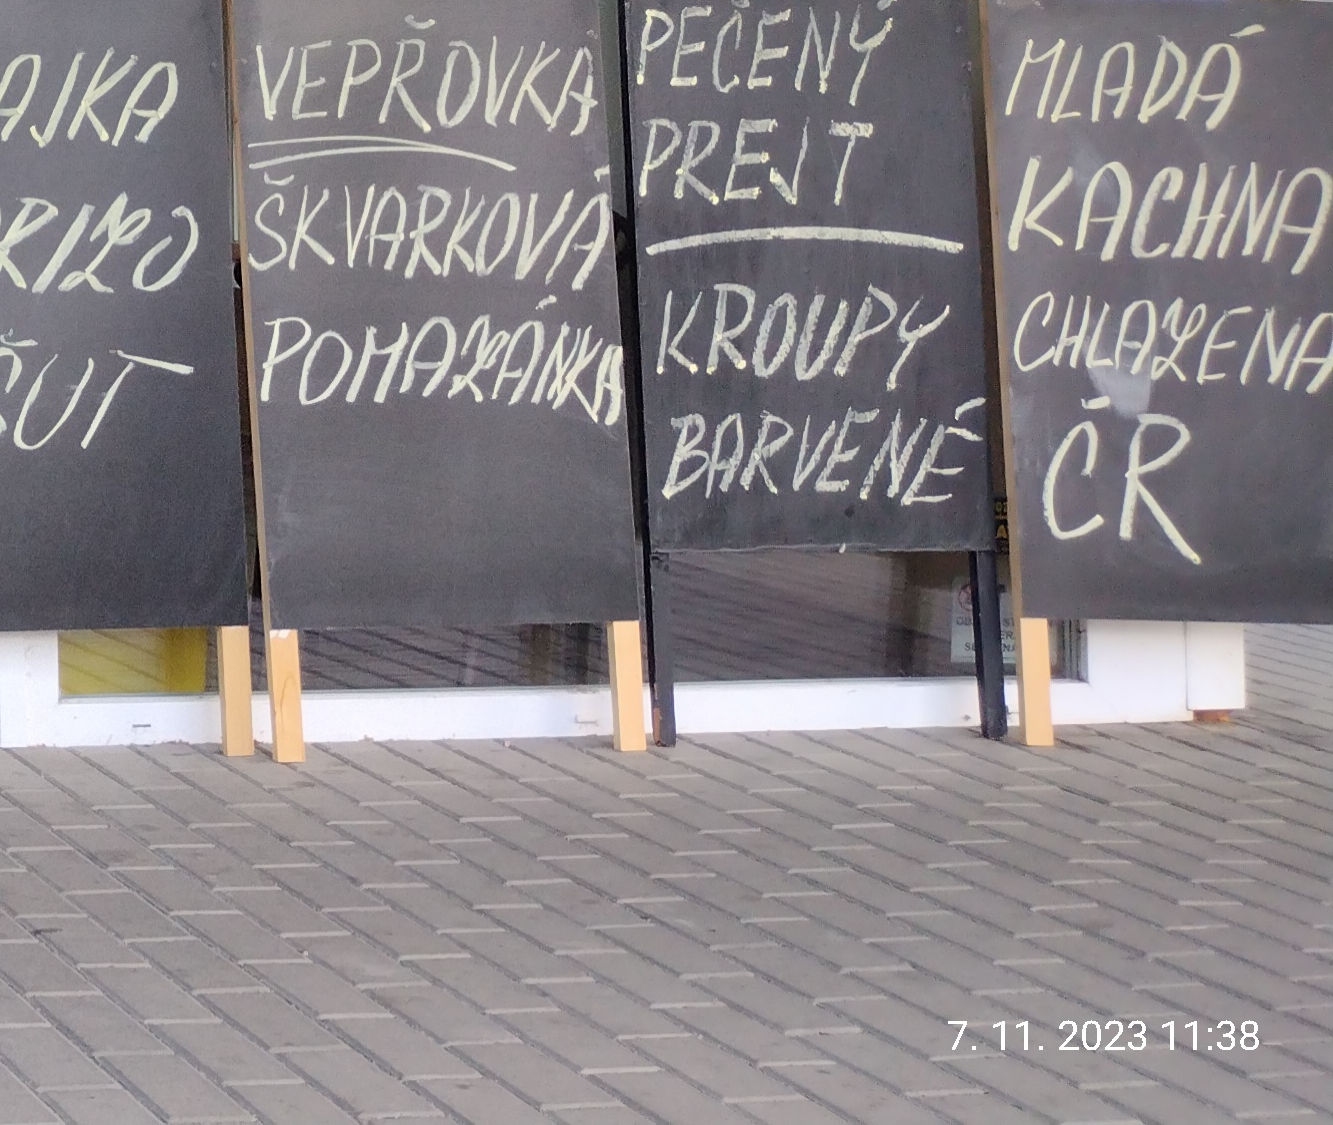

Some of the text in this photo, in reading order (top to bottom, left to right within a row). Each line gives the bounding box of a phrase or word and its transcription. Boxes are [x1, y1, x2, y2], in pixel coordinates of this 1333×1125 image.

[255, 15, 598, 137] VEPŘOVKA
[1005, 24, 1266, 131] MLADÁ
[638, 118, 874, 206] PREJT
[1007, 154, 1333, 275] KACHNA
[248, 165, 611, 291] ŠKVARKOVÁ
[260, 295, 624, 426] POMAZÁNKA
[656, 282, 950, 392] KROUPY
[661, 397, 987, 506] BARVENÉ
[1043, 396, 1201, 565] ČR
